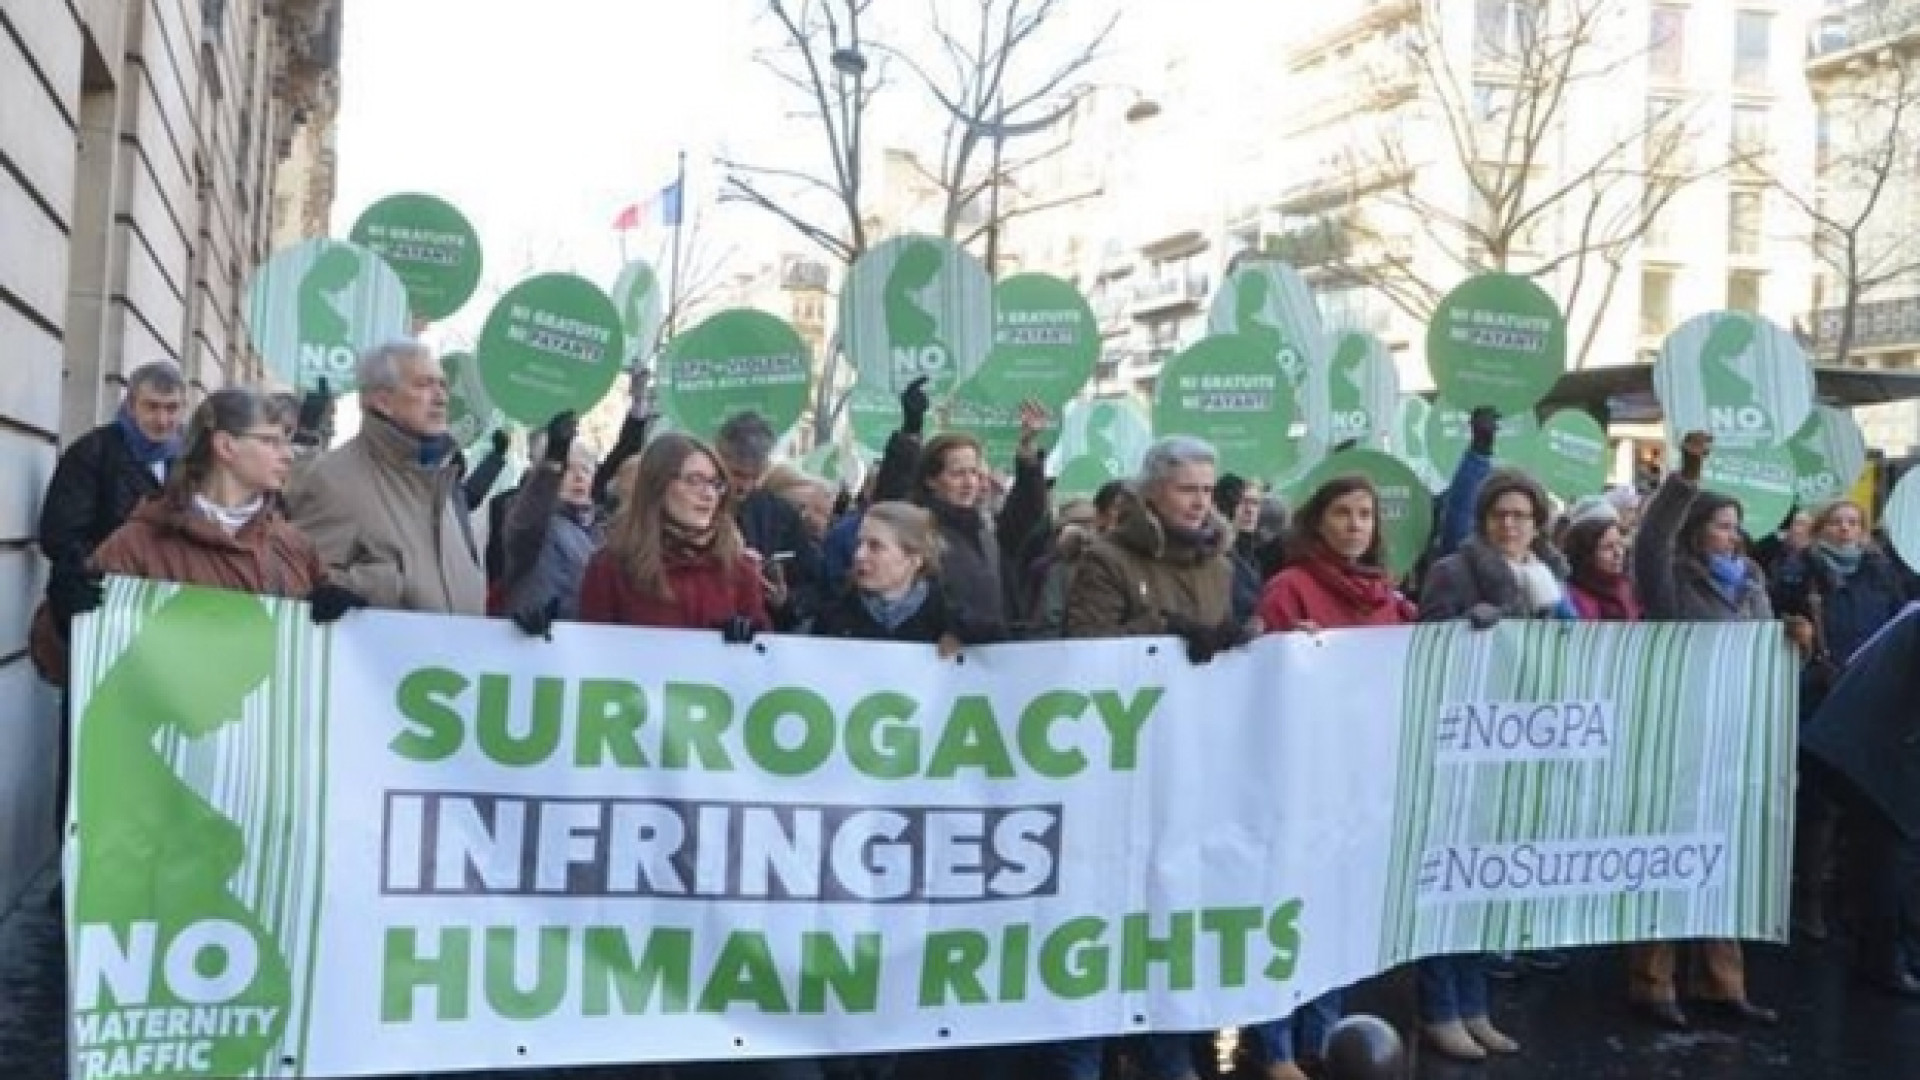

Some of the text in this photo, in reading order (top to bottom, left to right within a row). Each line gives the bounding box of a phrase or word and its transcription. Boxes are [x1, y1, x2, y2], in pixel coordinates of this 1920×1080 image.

[533, 308, 611, 344] GRATUITE
[1008, 310, 1080, 323] GRATUITE
[1473, 308, 1552, 332] GRATUITE
[302, 344, 354, 370] NO
[894, 346, 946, 372] NO
[1200, 374, 1275, 389] GRATUITE
[1333, 411, 1367, 428] NO
[1710, 406, 1764, 429] NO
[388, 666, 1164, 780] SURROGACY
[1436, 702, 1608, 749] #NoGPA
[385, 795, 1058, 899] INFRINGES
[1416, 844, 1722, 891] #NoSurrogacy
[76, 919, 258, 1010] NO
[380, 897, 1303, 1024] HUMAN RIGHTS
